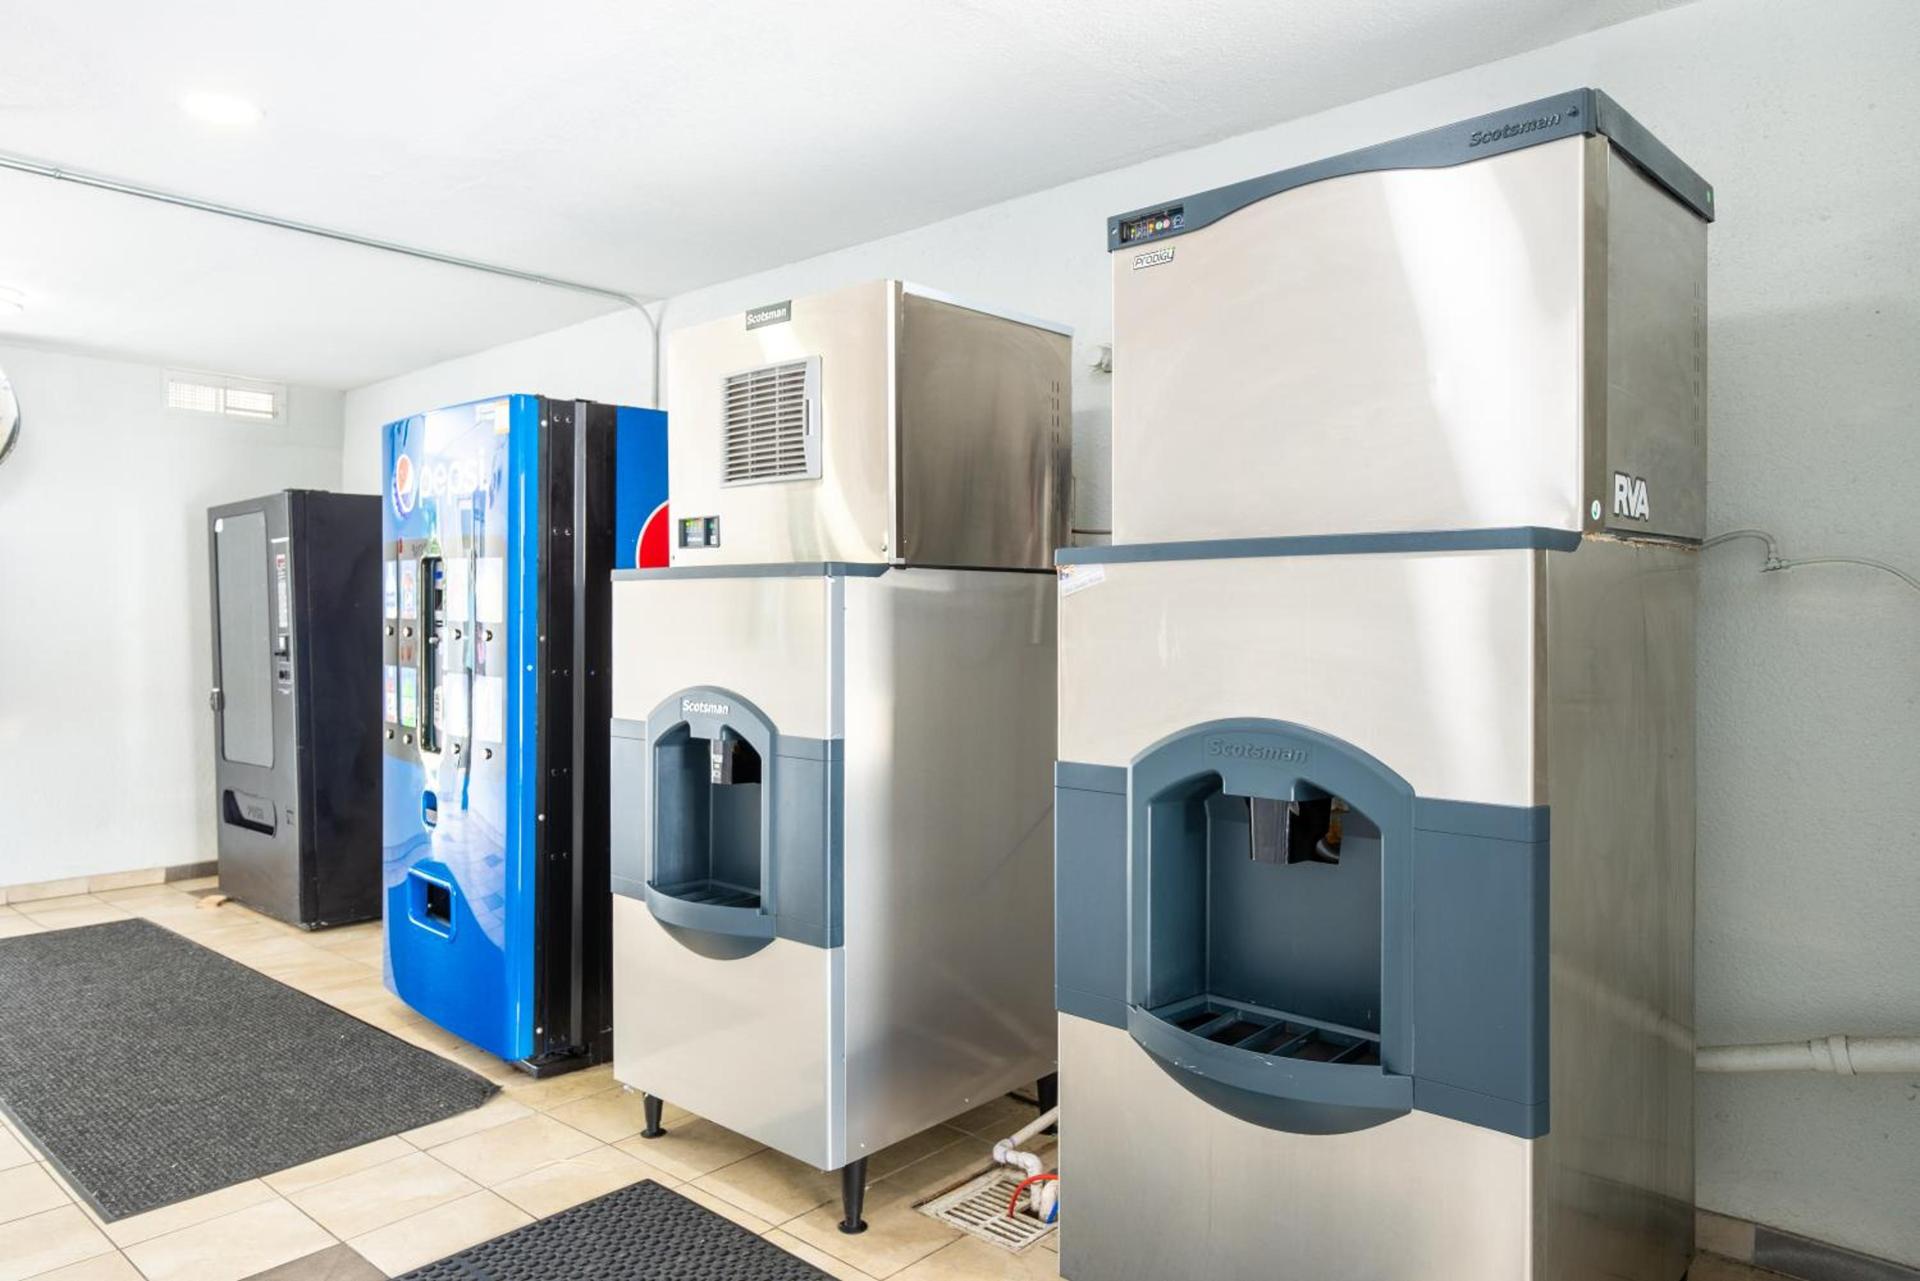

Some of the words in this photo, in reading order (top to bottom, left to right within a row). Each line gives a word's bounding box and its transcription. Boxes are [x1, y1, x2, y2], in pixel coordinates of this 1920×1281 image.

[1469, 112, 1561, 147] Scotsman
[747, 308, 787, 325] Scotsman
[419, 447, 487, 508] pepsi
[1613, 472, 1650, 521] RVA
[682, 699, 729, 715] Scotsman
[1208, 738, 1308, 763] Scotsman
